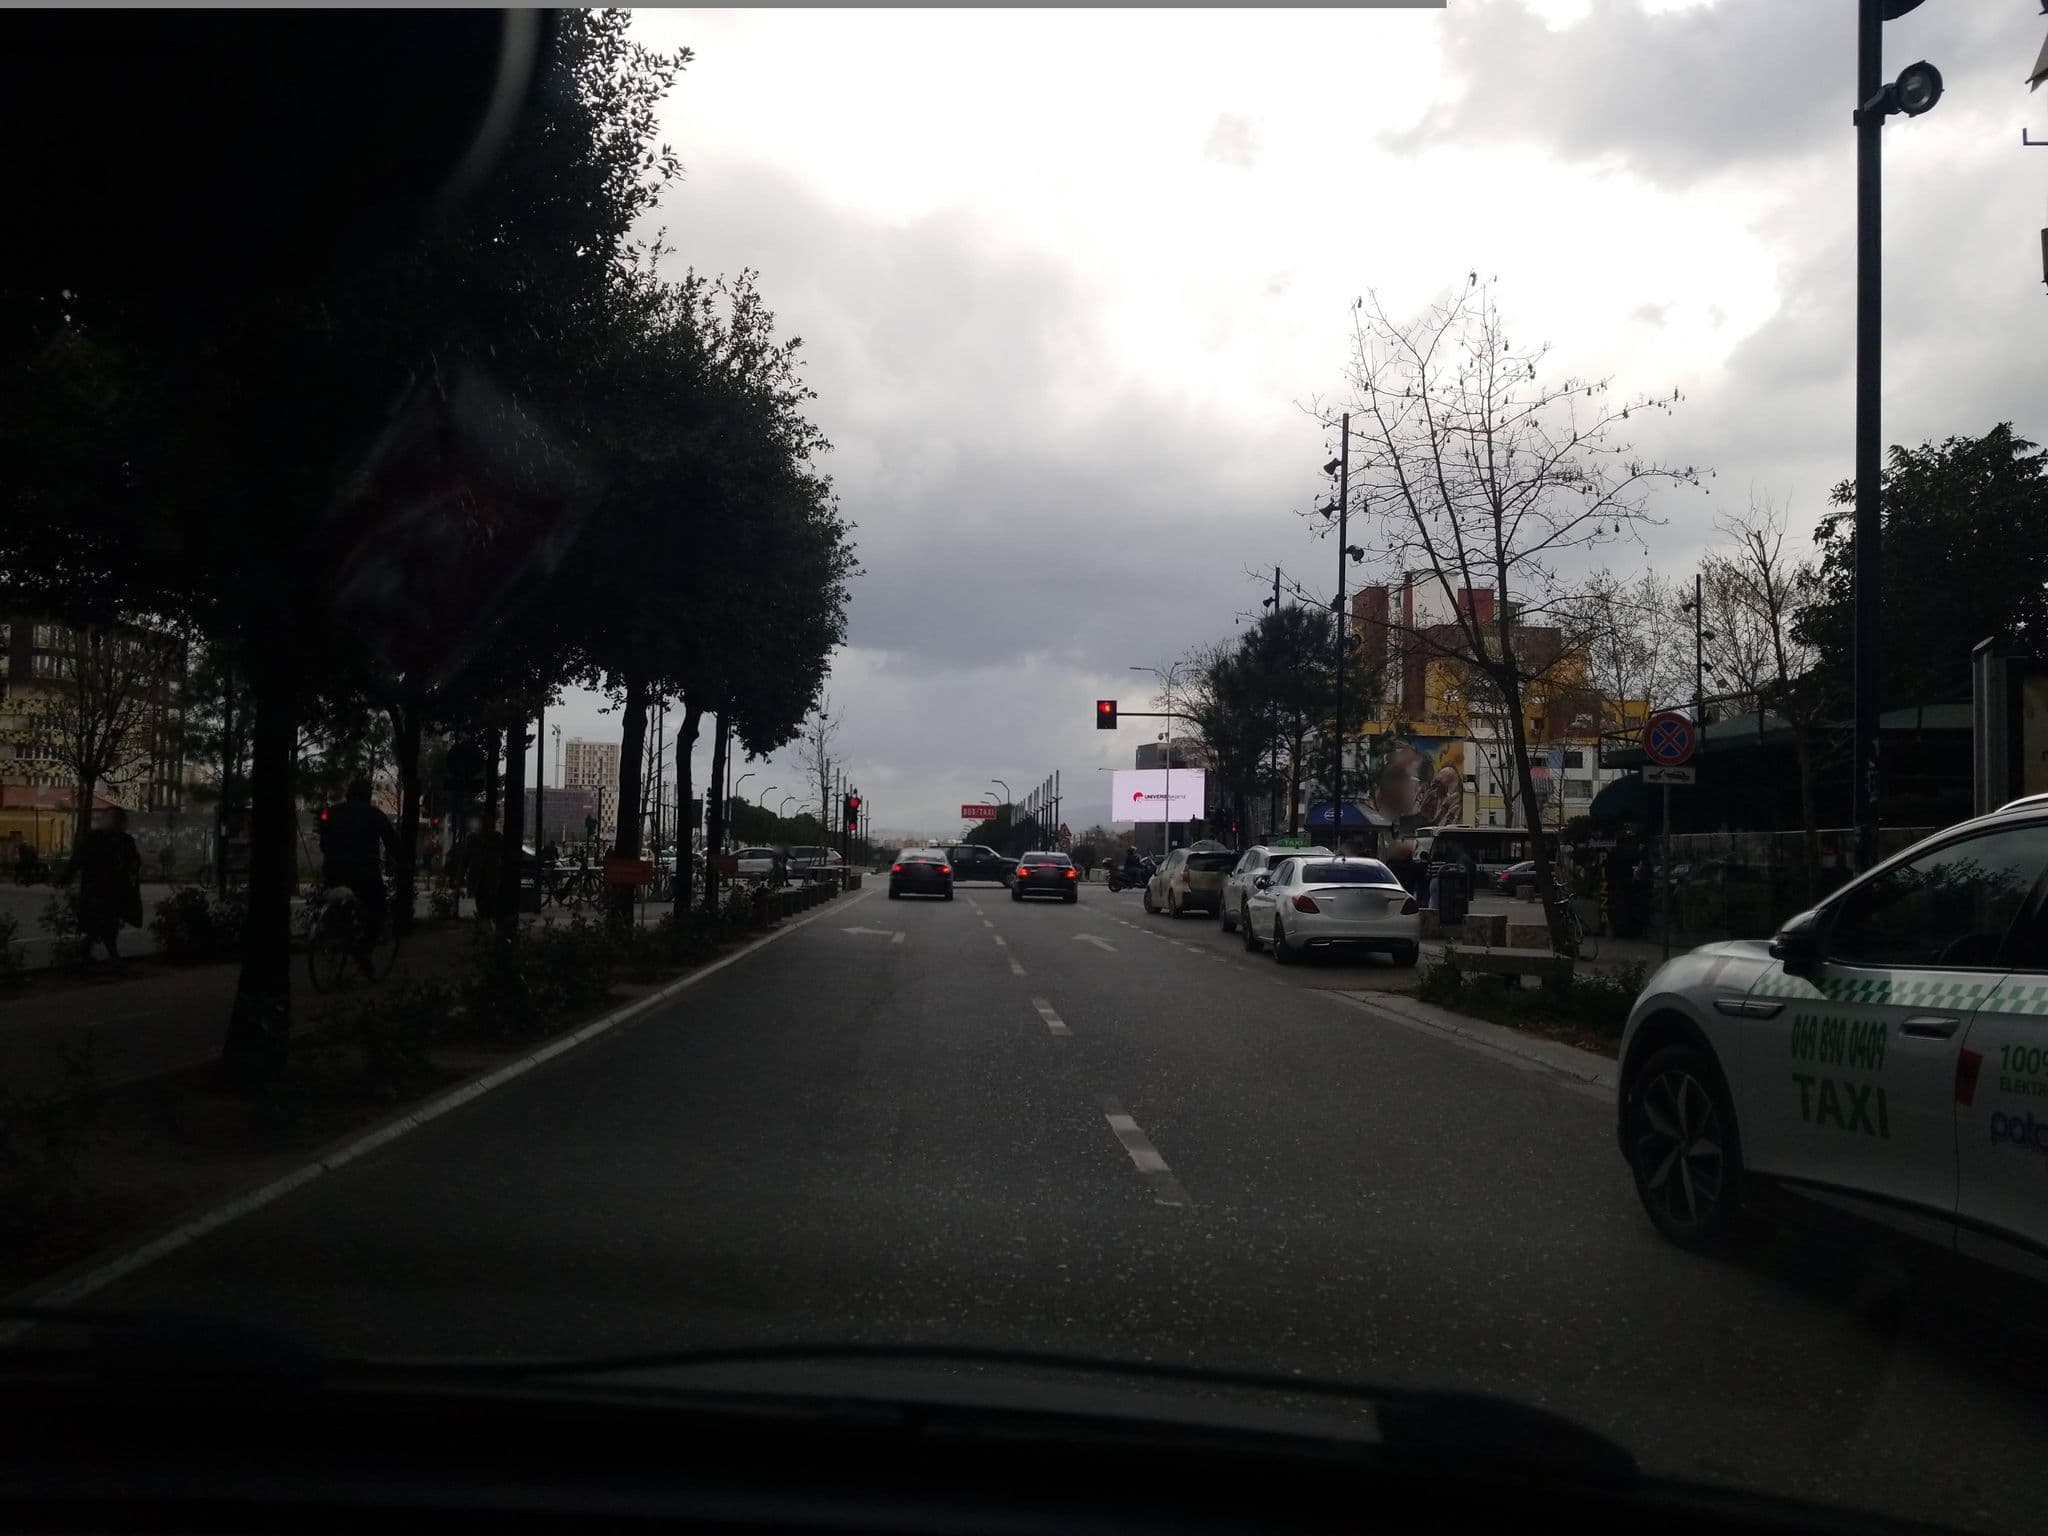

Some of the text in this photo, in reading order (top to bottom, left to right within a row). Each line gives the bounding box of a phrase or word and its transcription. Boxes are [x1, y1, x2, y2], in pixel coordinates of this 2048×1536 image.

[963, 808, 994, 816] BUS/TAXI
[1599, 851, 1609, 923] PIZZA
[1792, 1072, 1890, 1140] TAXI
